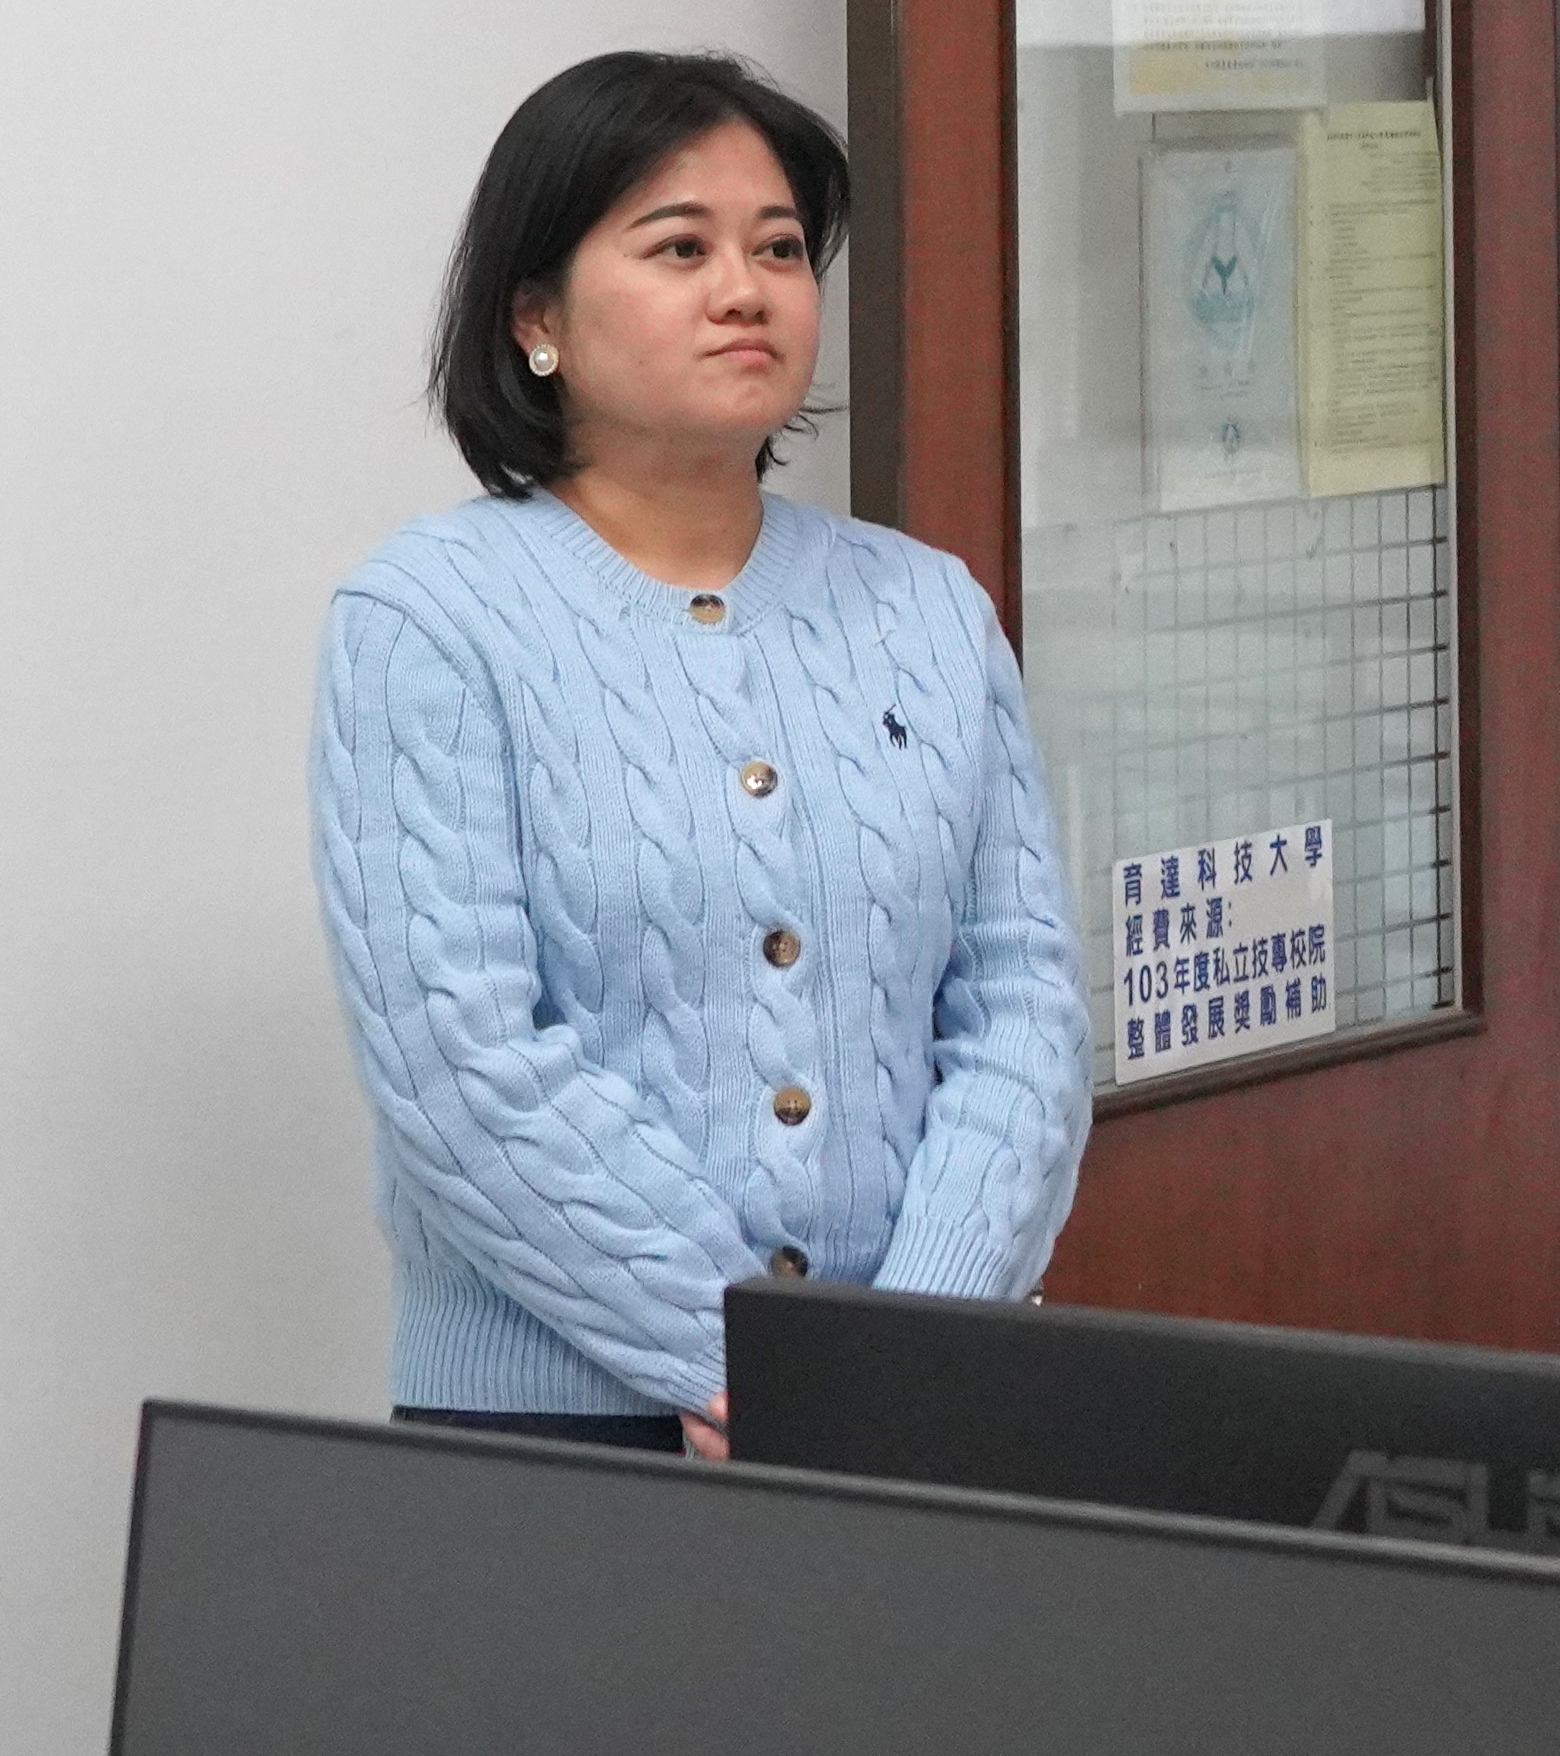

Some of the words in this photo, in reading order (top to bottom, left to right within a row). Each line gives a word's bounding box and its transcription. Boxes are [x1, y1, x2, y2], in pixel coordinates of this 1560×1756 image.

[1122, 825, 1323, 907] 育達科技大學
[1123, 924, 1326, 1007] 103年度私立技專校院
[1126, 972, 1328, 1061] 整體發展獎勵補助
